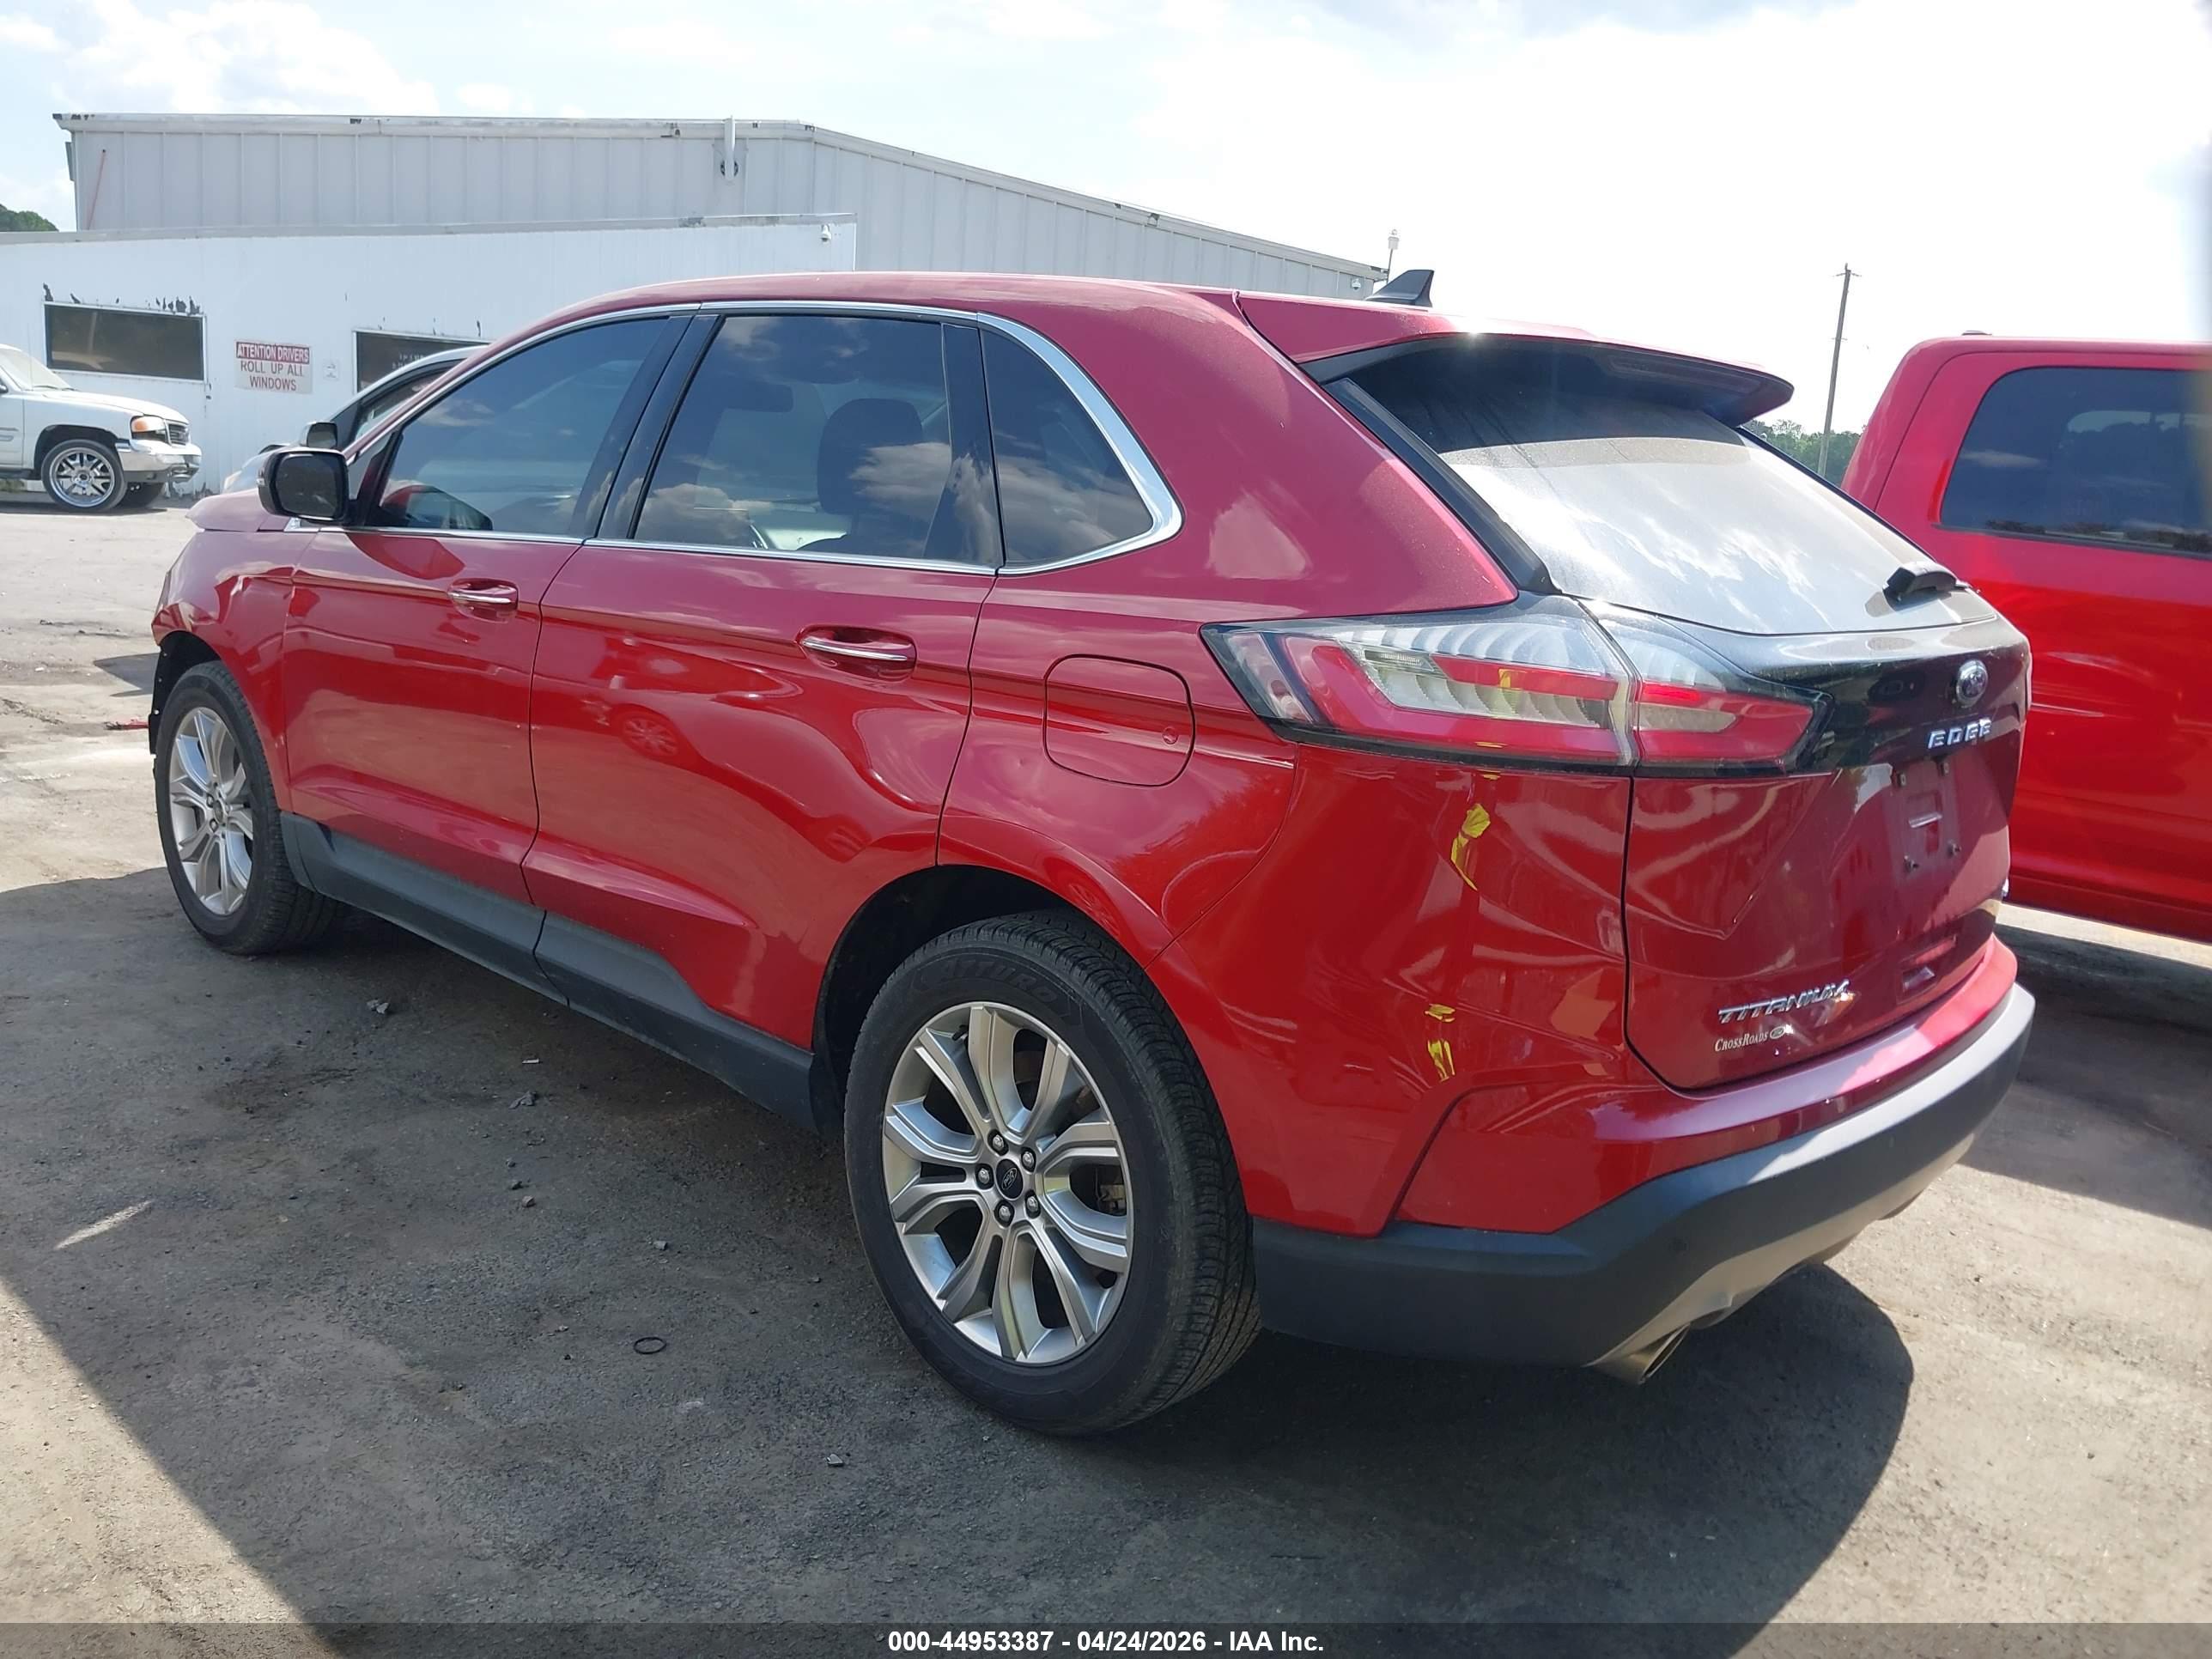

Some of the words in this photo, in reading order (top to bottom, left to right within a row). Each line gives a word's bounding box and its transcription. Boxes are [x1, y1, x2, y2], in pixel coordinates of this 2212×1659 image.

[237, 343, 276, 361] ATTENTION
[276, 345, 309, 364] DRIVERS
[240, 360, 266, 374] ROLL
[270, 362, 283, 375] UP
[287, 364, 304, 378] ALL
[249, 375, 297, 392] WINDOWS
[1927, 717, 1992, 750] EDGE
